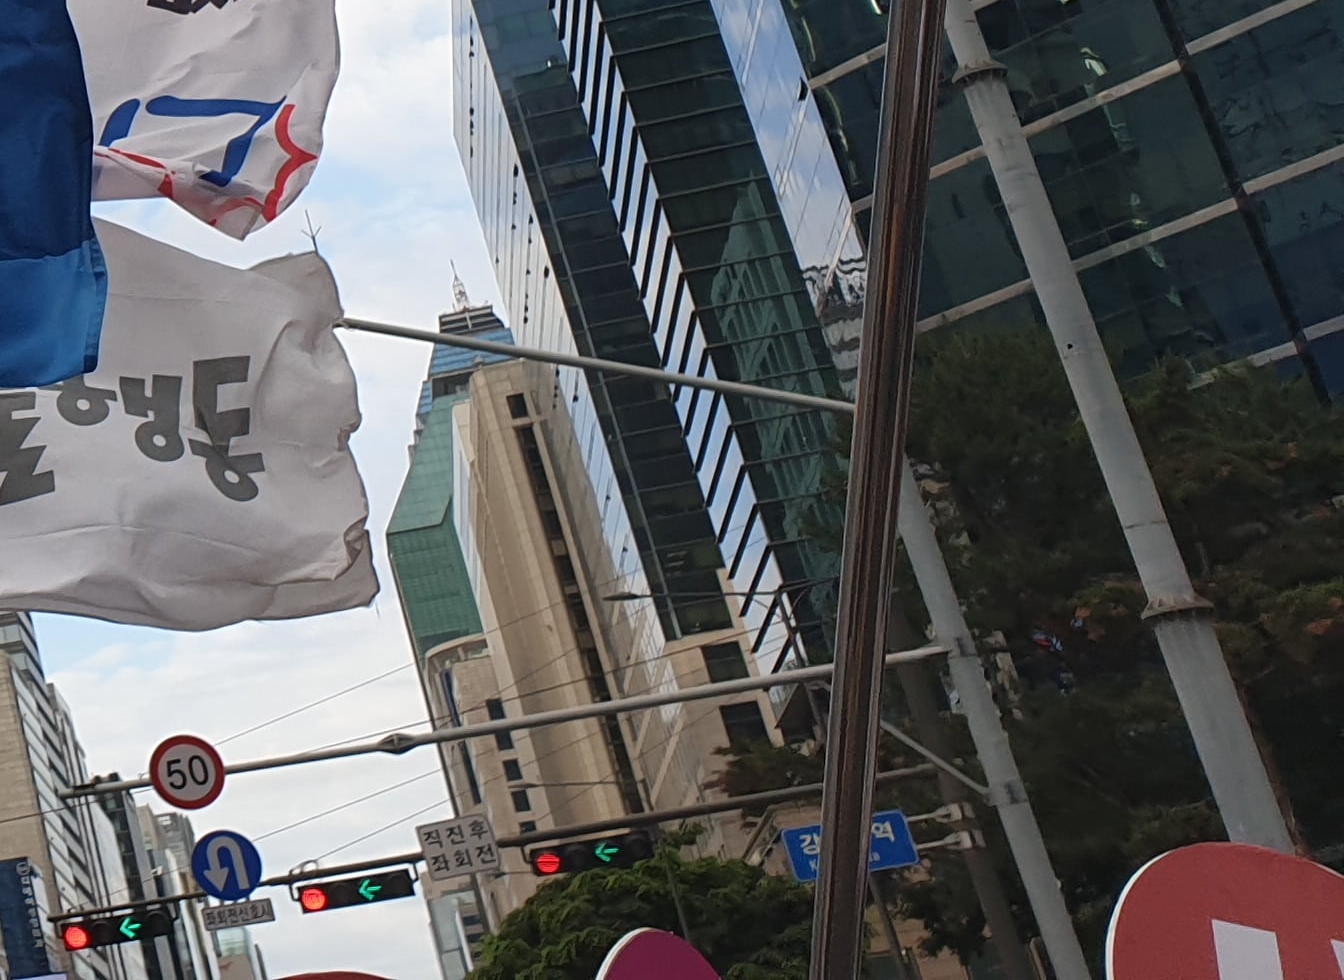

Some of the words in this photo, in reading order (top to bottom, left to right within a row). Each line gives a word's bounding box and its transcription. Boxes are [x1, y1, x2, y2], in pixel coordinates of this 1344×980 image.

[165, 754, 210, 790] 50
[423, 820, 489, 848] 직진후
[431, 843, 497, 872] 좌회전
